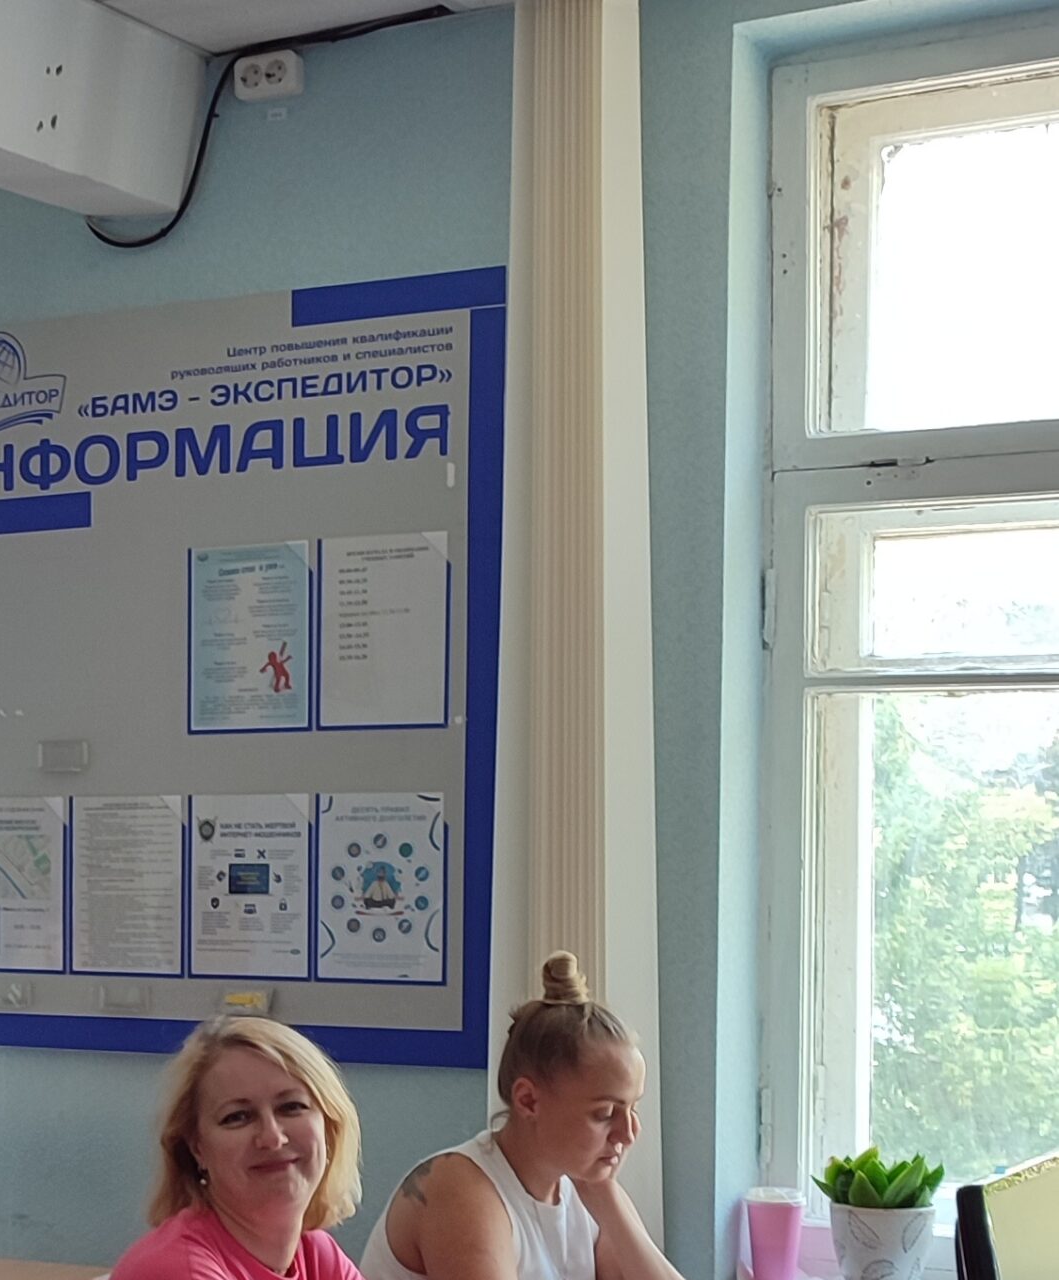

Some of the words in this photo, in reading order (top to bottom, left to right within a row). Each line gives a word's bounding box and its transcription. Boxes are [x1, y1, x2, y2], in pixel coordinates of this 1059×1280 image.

[226, 345, 267, 358] Центр
[270, 334, 348, 353] повышения
[351, 325, 454, 346] квалификации
[260, 353, 339, 371] работников
[342, 352, 352, 361] и
[354, 341, 454, 361] специалистов
[77, 388, 179, 420] «БАМЭ
[210, 363, 454, 407] ЭКСПЕДИТОР»
